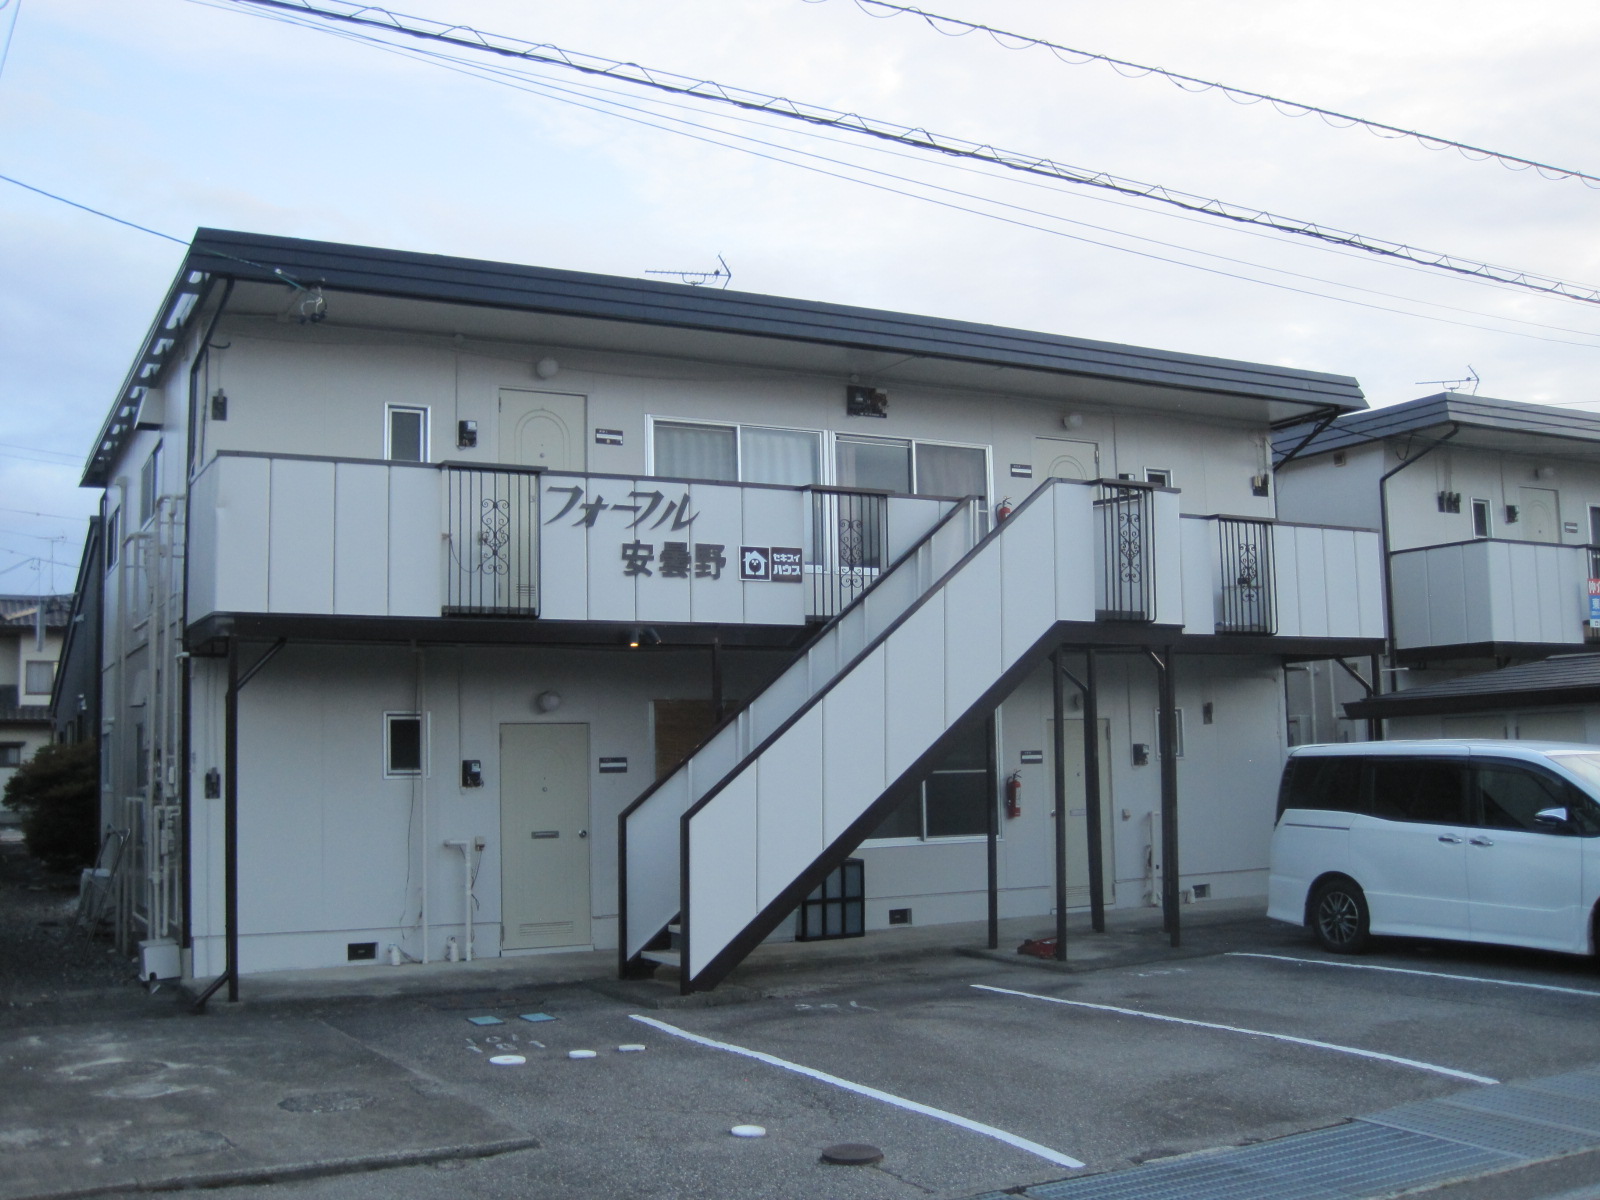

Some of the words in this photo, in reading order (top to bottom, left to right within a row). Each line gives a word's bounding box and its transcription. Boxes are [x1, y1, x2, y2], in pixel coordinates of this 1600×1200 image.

[621, 539, 728, 580] 安曇野
[772, 553, 801, 563] セキスイ
[772, 564, 801, 576] ハウス
